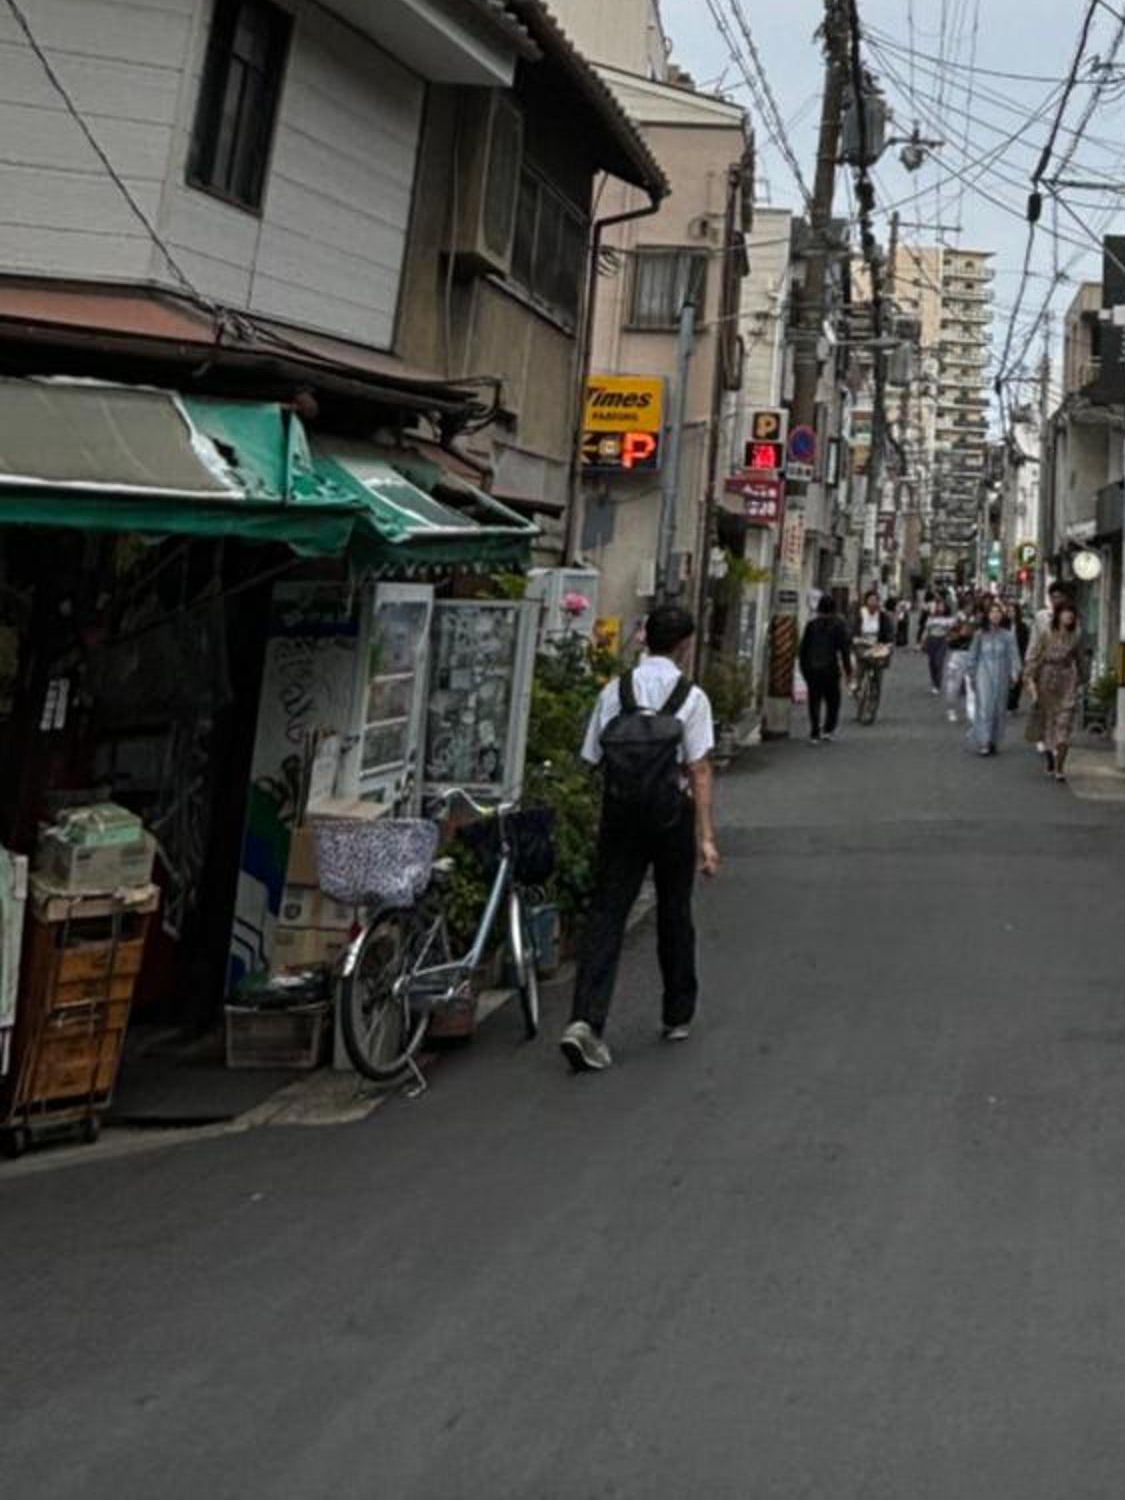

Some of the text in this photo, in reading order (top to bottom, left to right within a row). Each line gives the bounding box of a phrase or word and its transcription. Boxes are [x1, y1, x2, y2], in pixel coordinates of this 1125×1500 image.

[587, 387, 652, 408] Times
[756, 414, 777, 438] P
[622, 432, 656, 469] P
